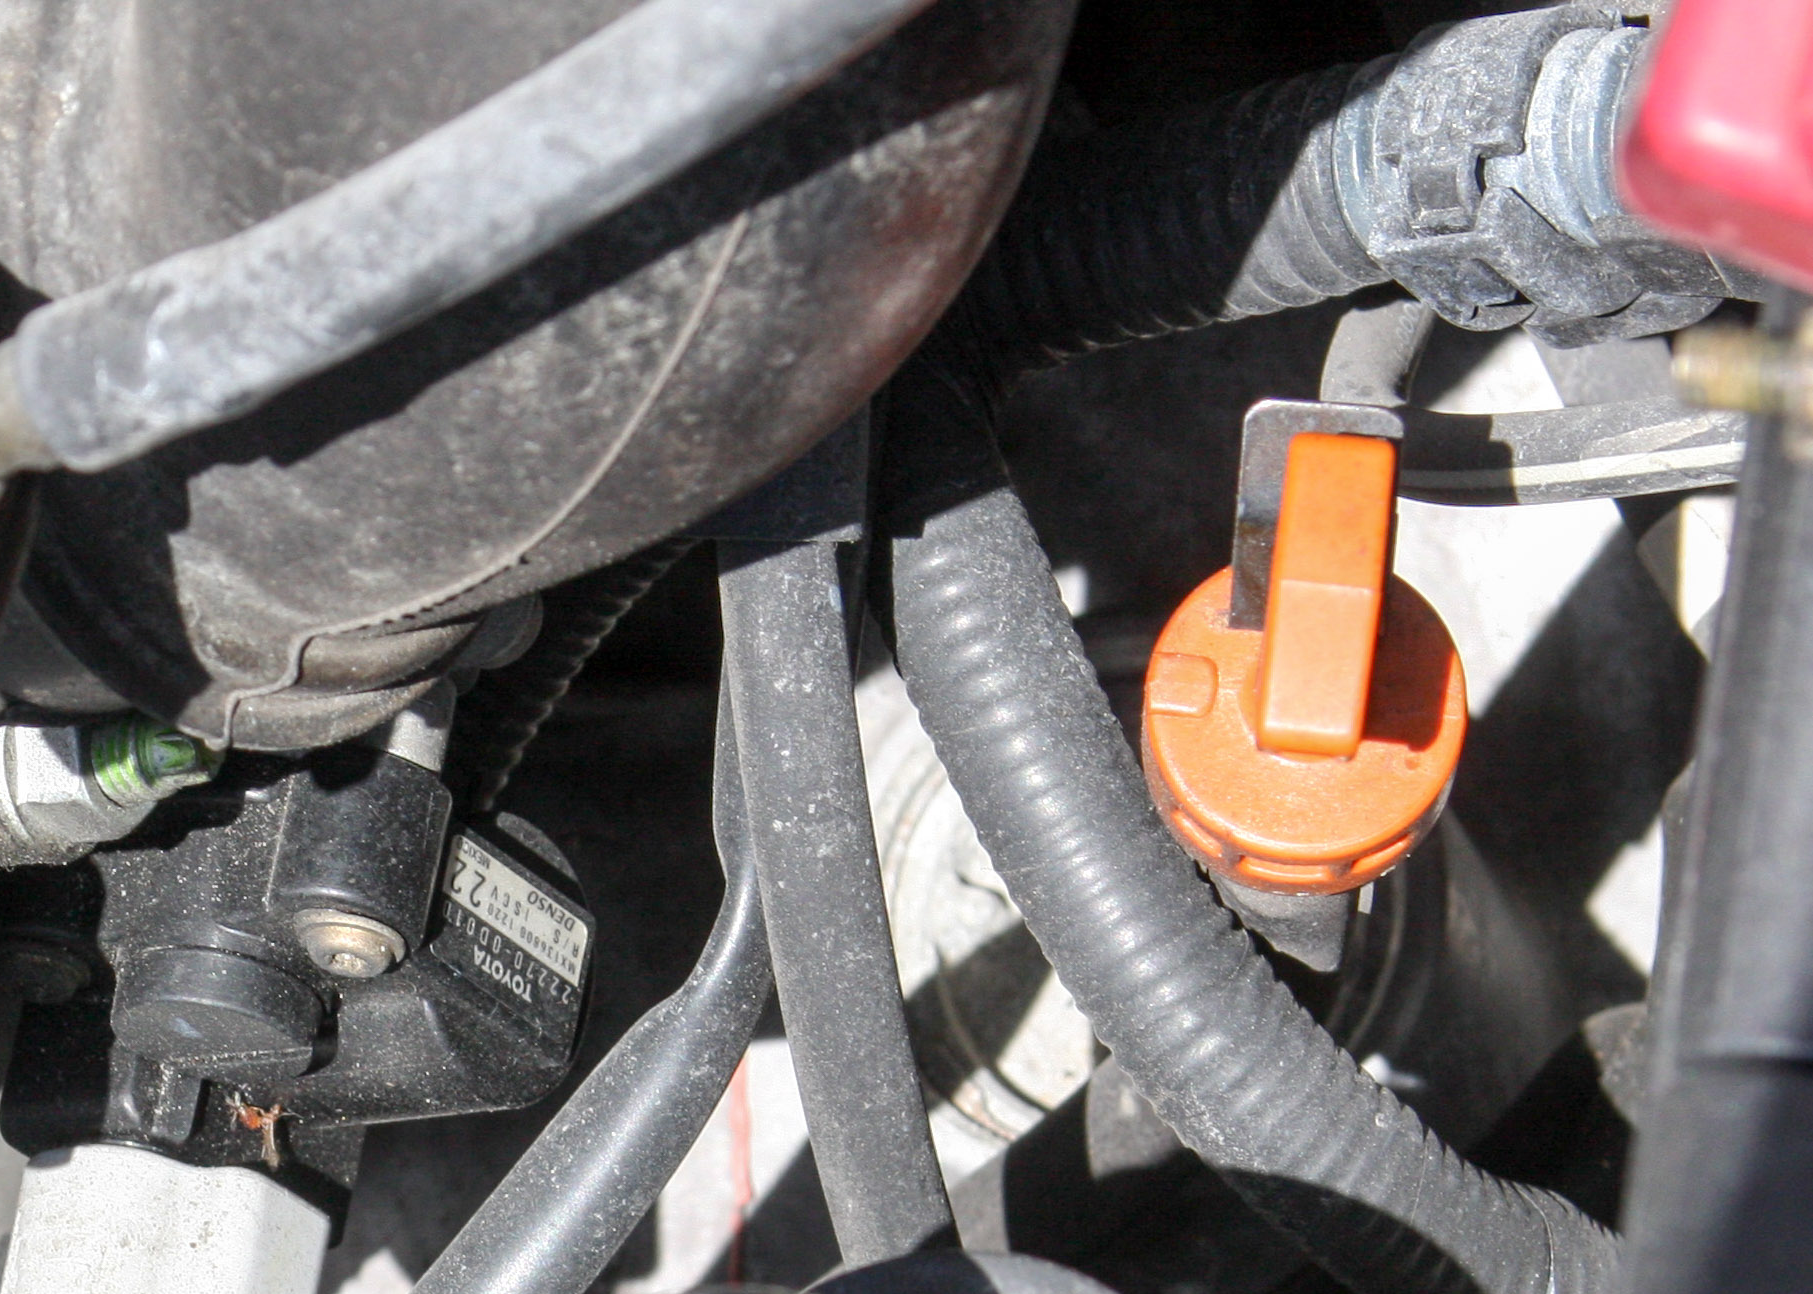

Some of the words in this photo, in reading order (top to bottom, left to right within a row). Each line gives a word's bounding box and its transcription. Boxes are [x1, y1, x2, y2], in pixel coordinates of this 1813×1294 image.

[456, 838, 492, 870] MEXICO
[450, 857, 486, 908] 22
[527, 890, 577, 932] DENSO
[473, 945, 532, 1003] TOYOTA
